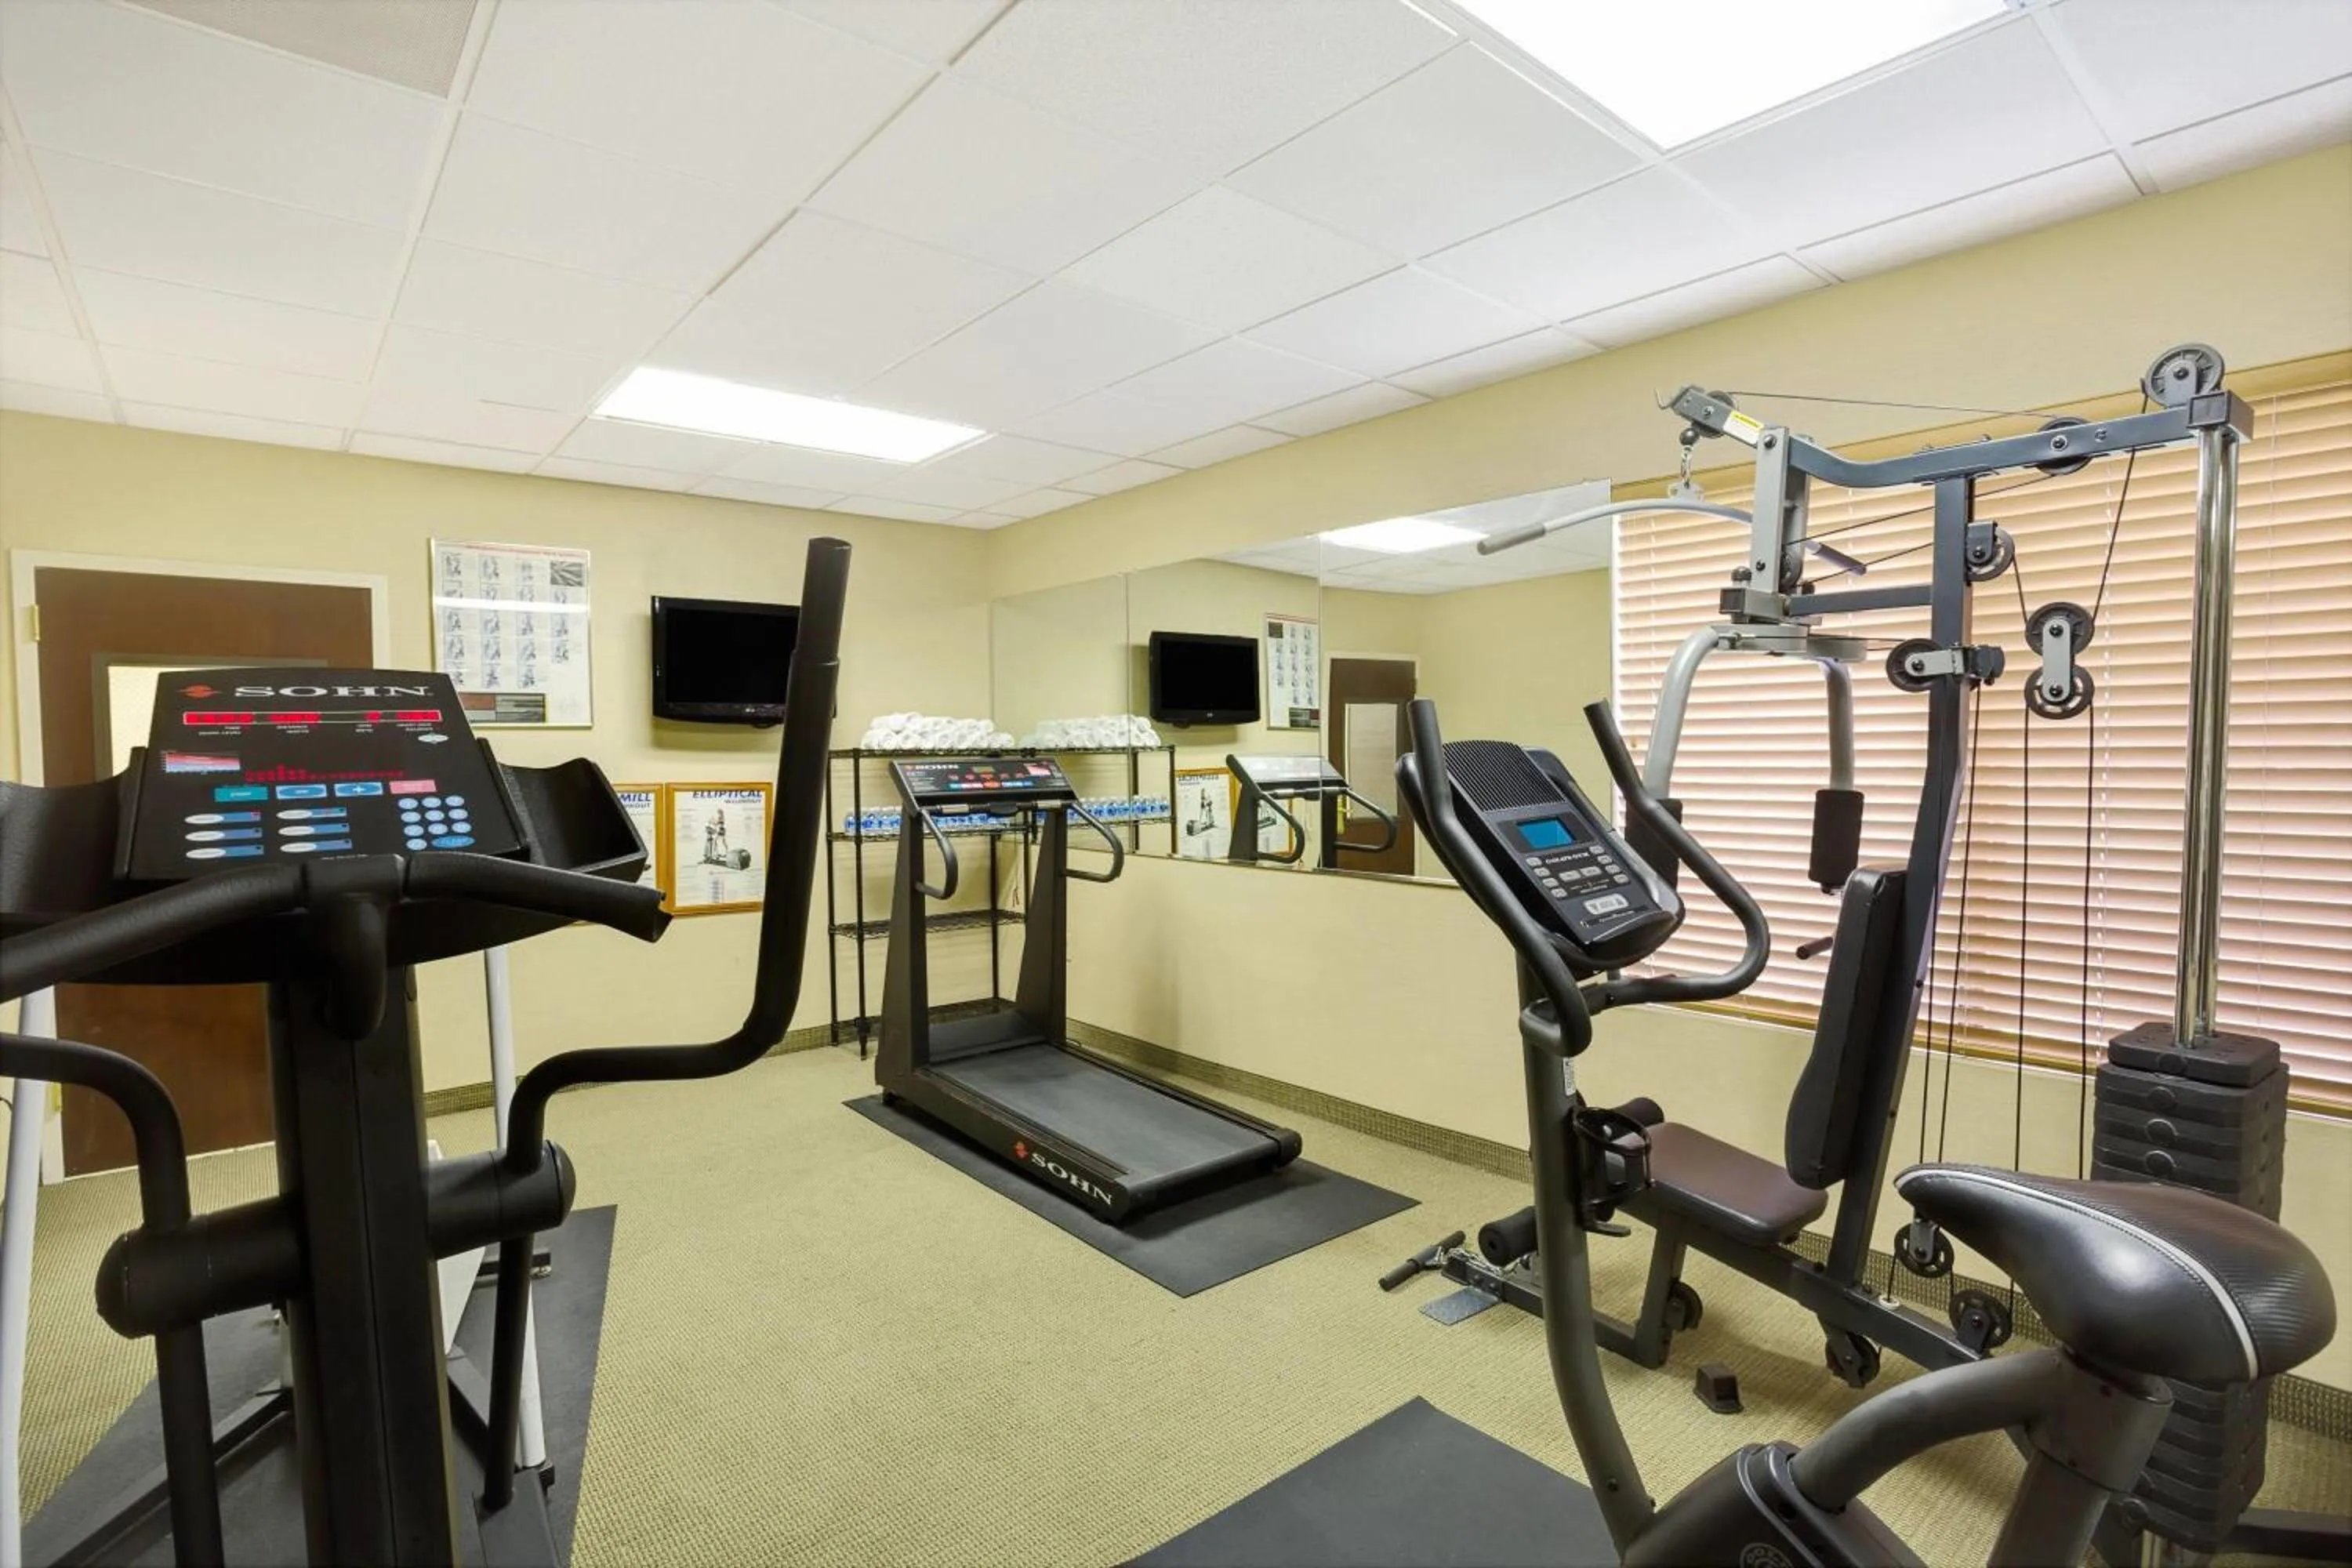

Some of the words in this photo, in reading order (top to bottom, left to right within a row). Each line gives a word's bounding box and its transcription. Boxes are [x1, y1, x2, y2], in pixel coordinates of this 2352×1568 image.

[234, 686, 430, 697] SOHN
[692, 790, 762, 799] ELLIPTICAL
[1031, 1152, 1112, 1205] SOHN
